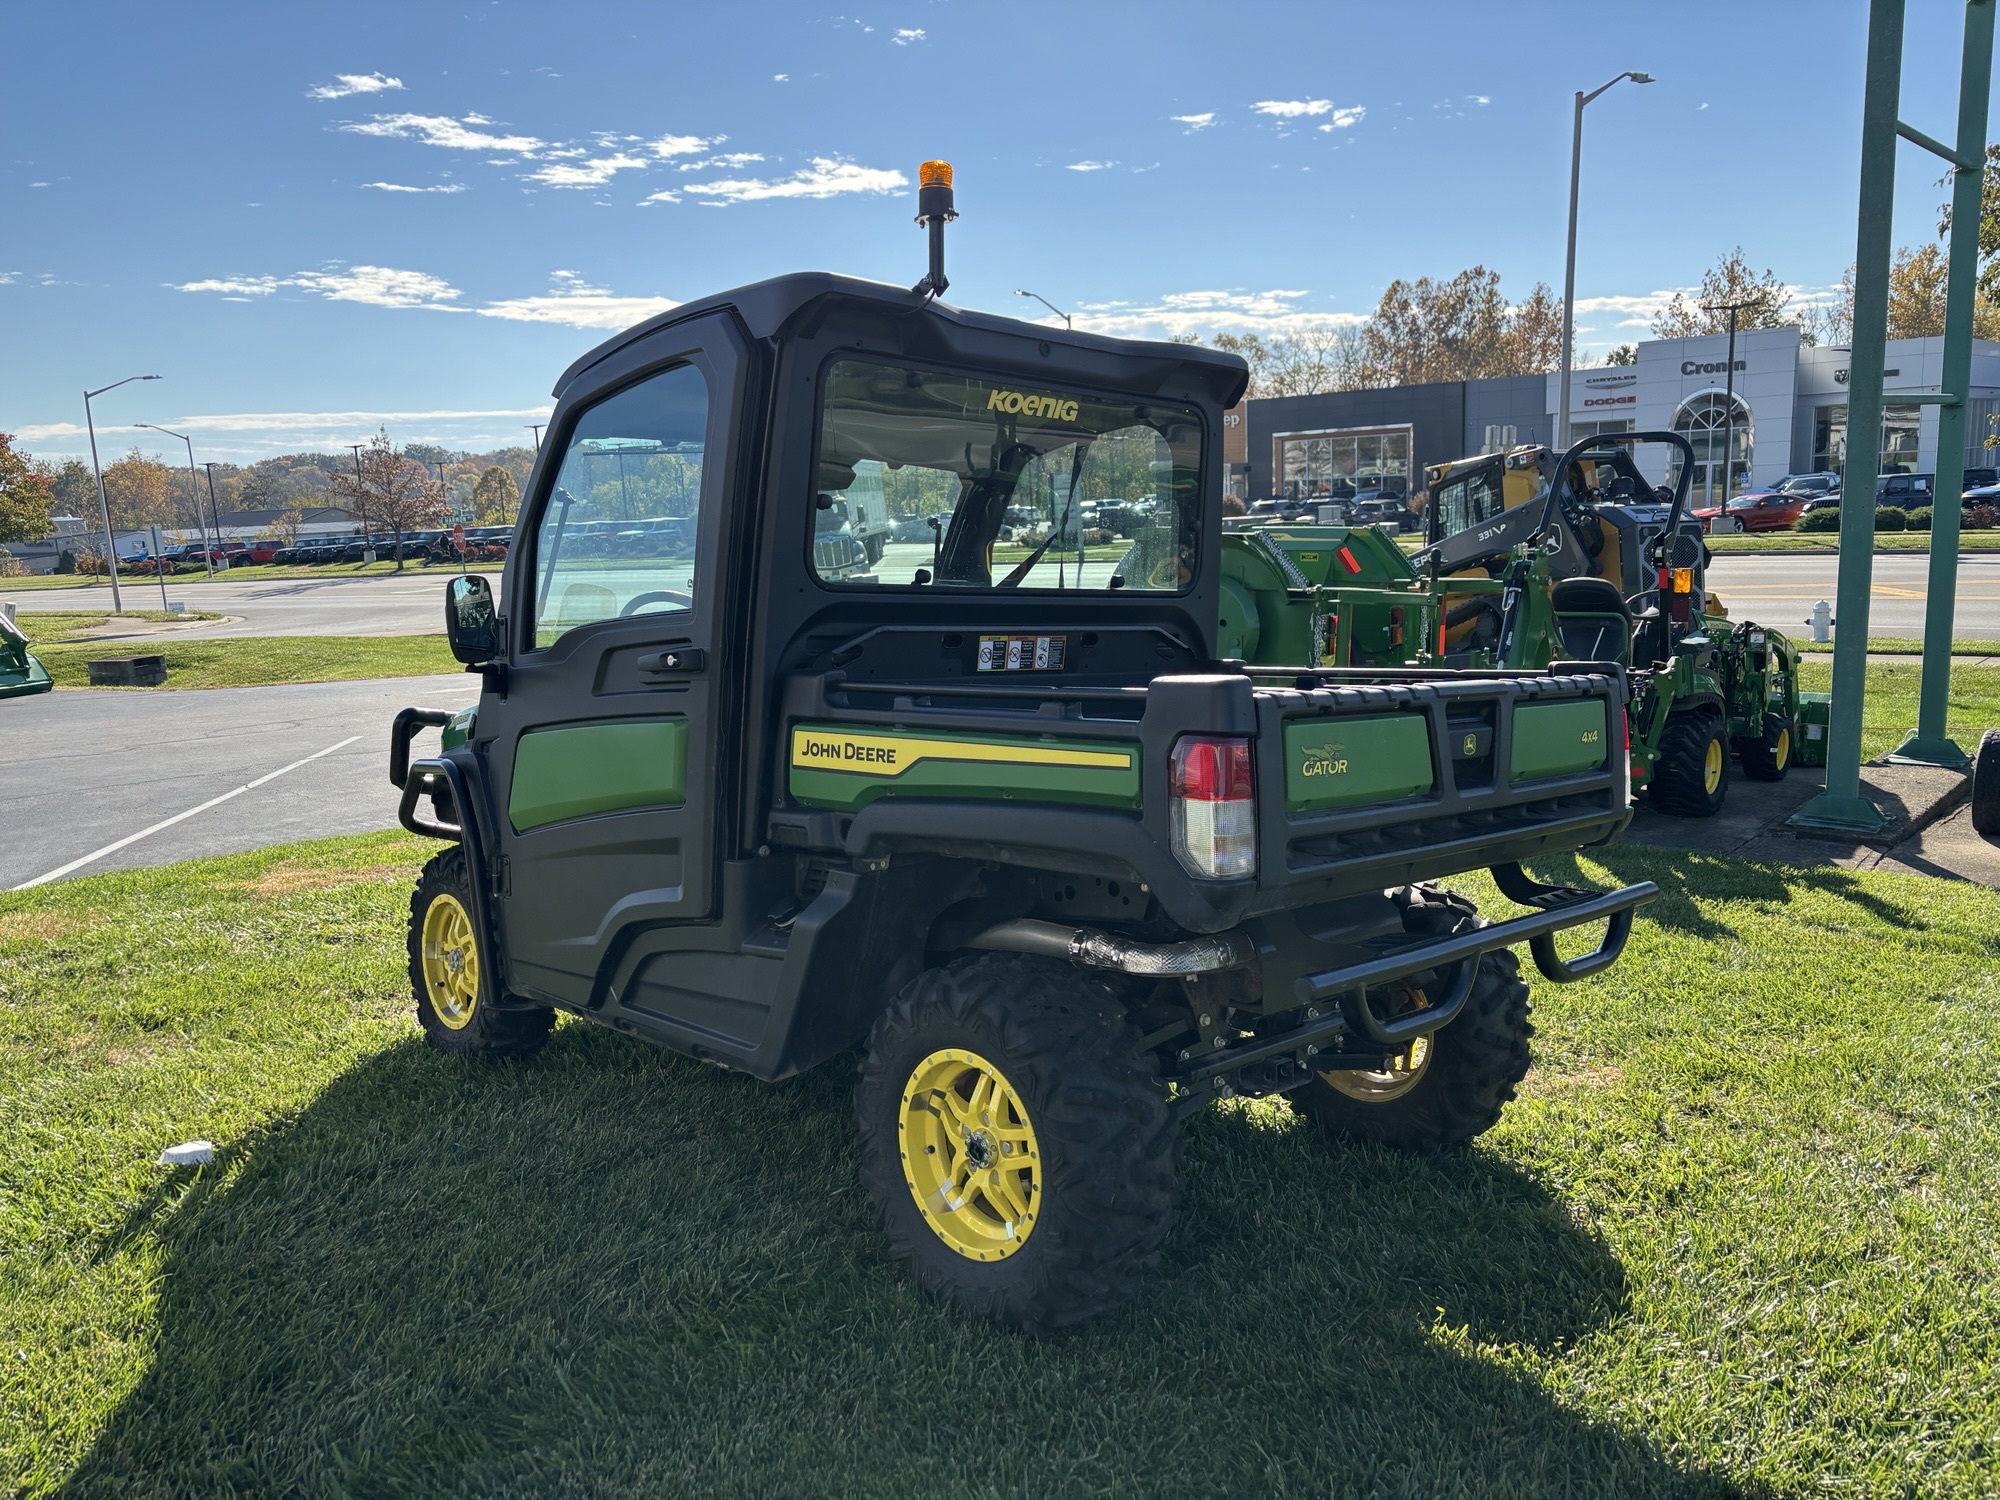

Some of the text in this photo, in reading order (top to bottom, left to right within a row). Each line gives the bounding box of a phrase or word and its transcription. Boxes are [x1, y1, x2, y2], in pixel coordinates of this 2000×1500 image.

[1681, 360, 1746, 375] Cronn
[1586, 375, 1637, 383] CHRYSLER
[1584, 396, 1636, 407] DODGE
[802, 739, 897, 764] JOHN DEERE
[1302, 759, 1348, 777] GATOR
